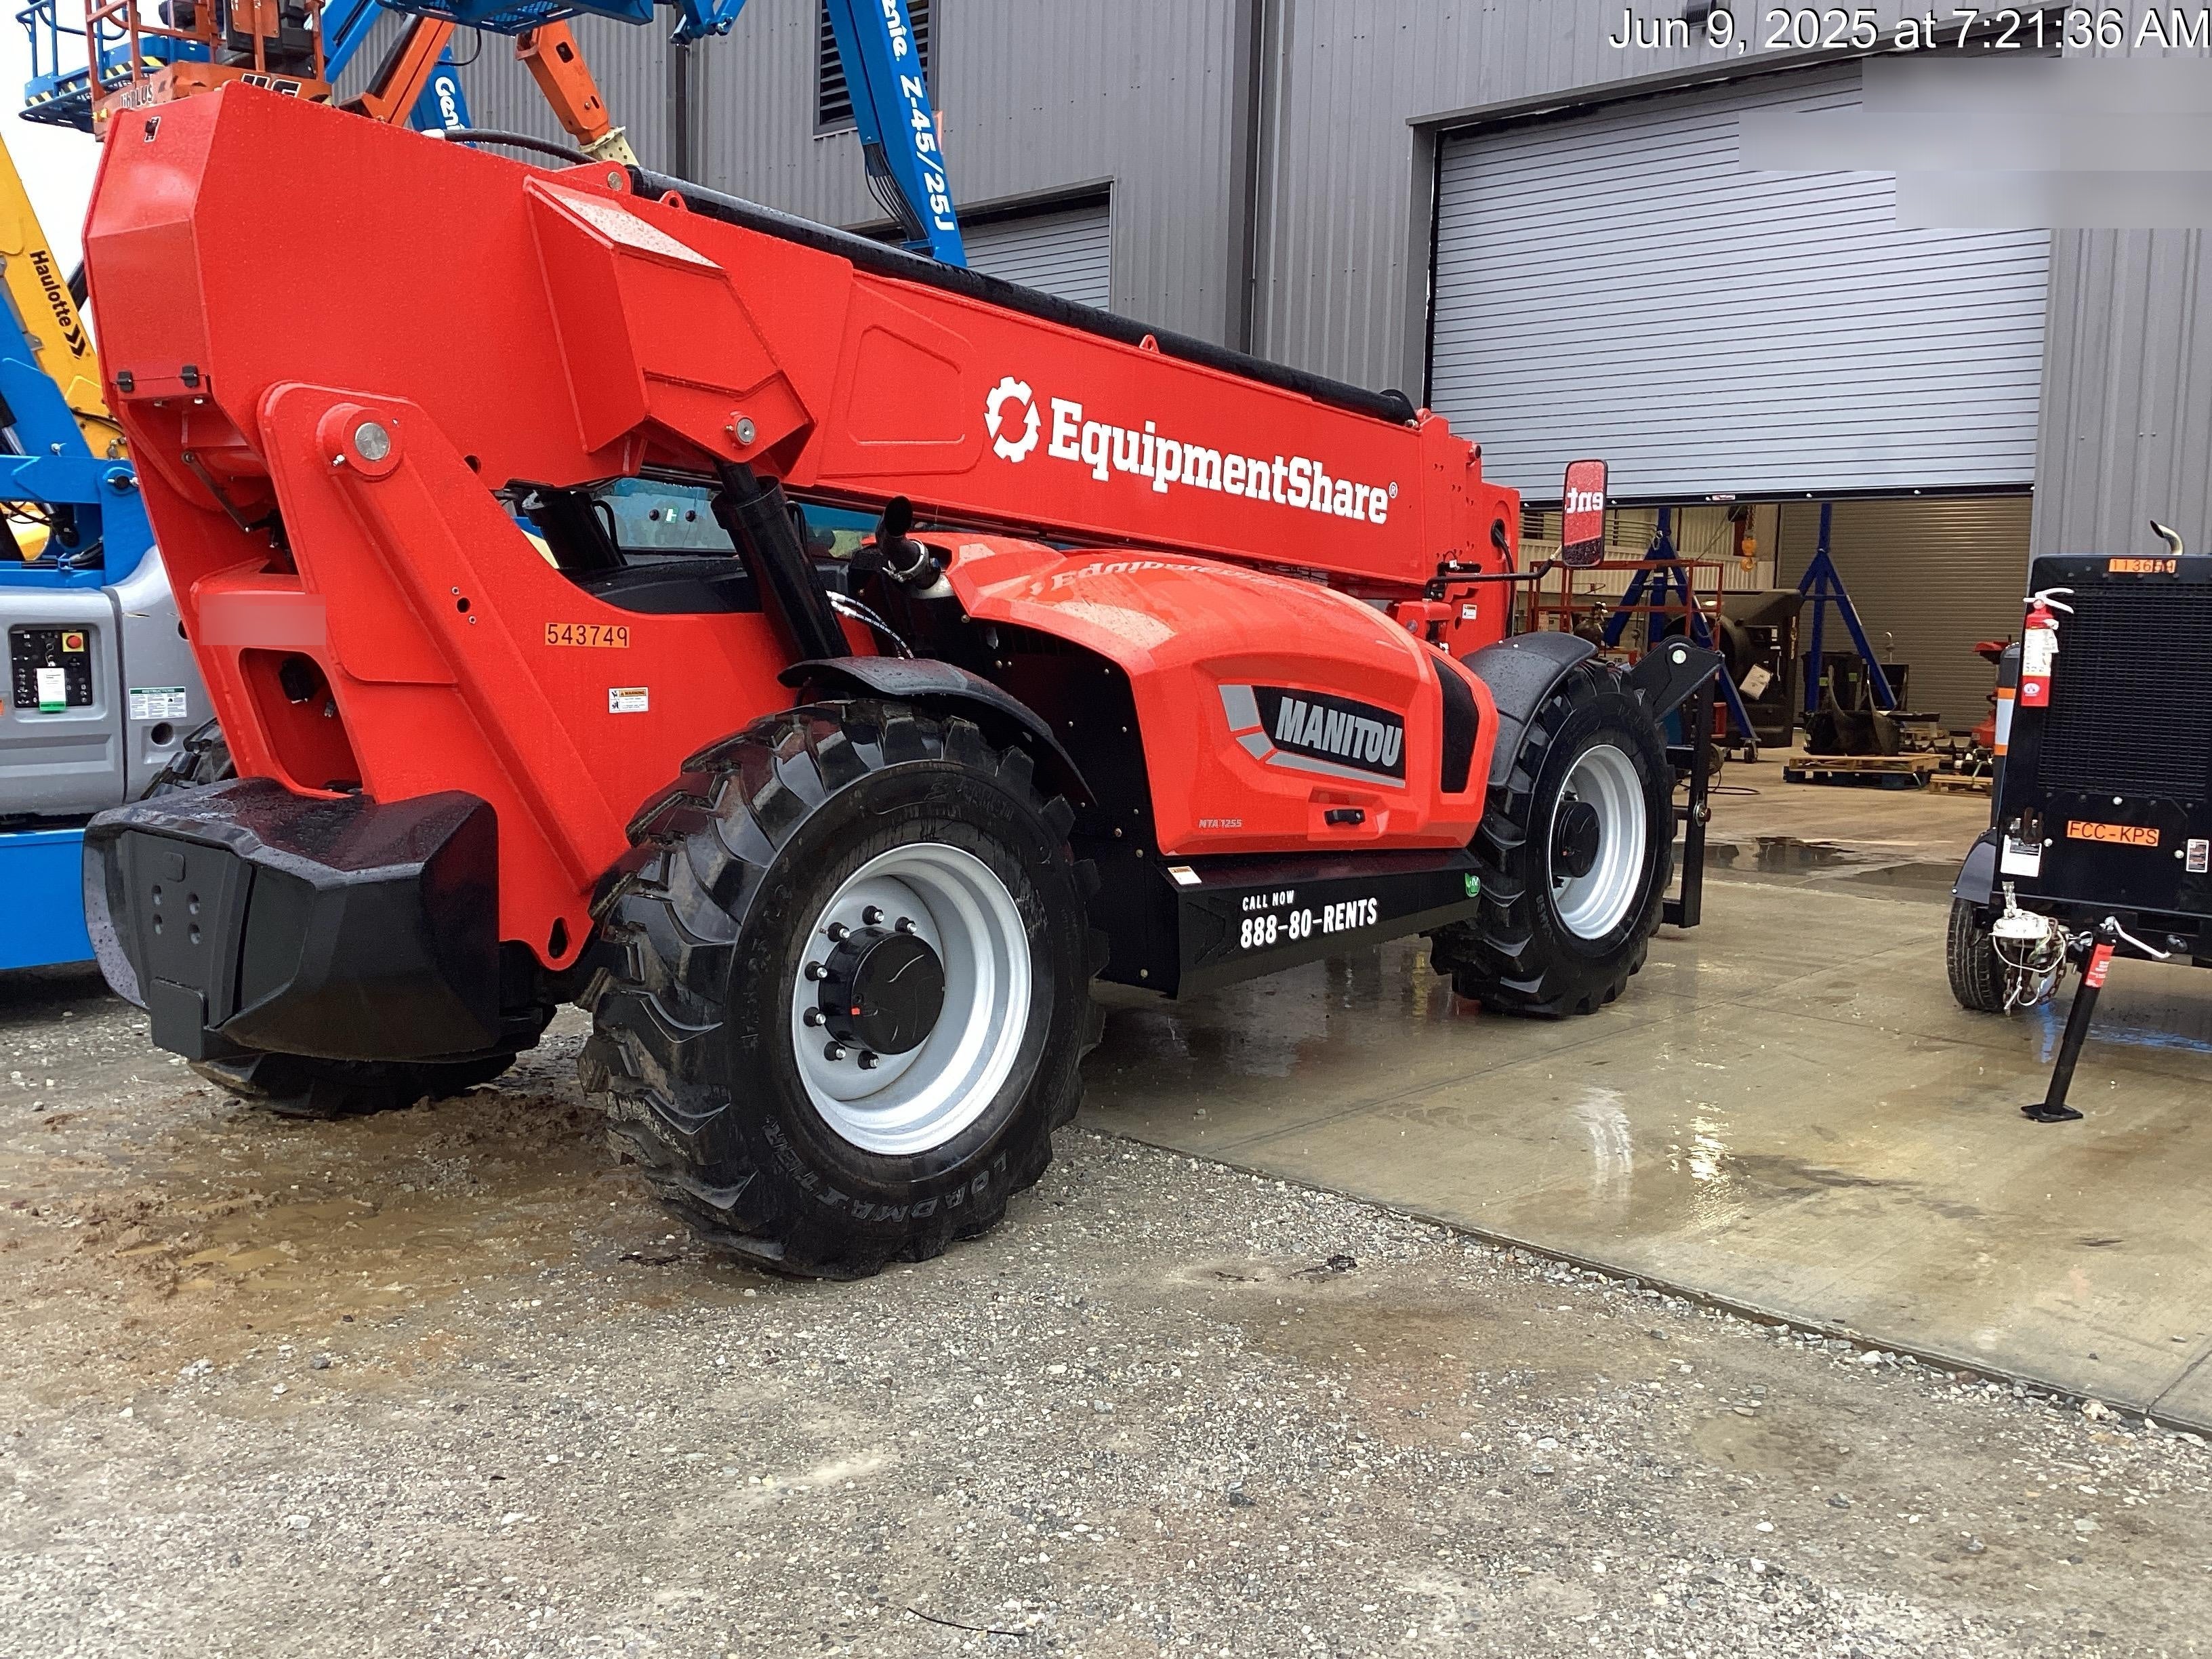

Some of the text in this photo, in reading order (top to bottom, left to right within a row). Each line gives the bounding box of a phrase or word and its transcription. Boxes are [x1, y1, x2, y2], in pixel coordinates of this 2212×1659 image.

[435, 77, 465, 131] Geni
[901, 75, 955, 230] Z-45/25J
[30, 250, 72, 327] Haulotte
[547, 623, 628, 647] 543749
[1275, 697, 1403, 766] MANITOU
[2070, 821, 2158, 844] FCC-KPS
[1240, 897, 1378, 949] 888-80-RENTS
[1242, 890, 1294, 912] CALL NOW
